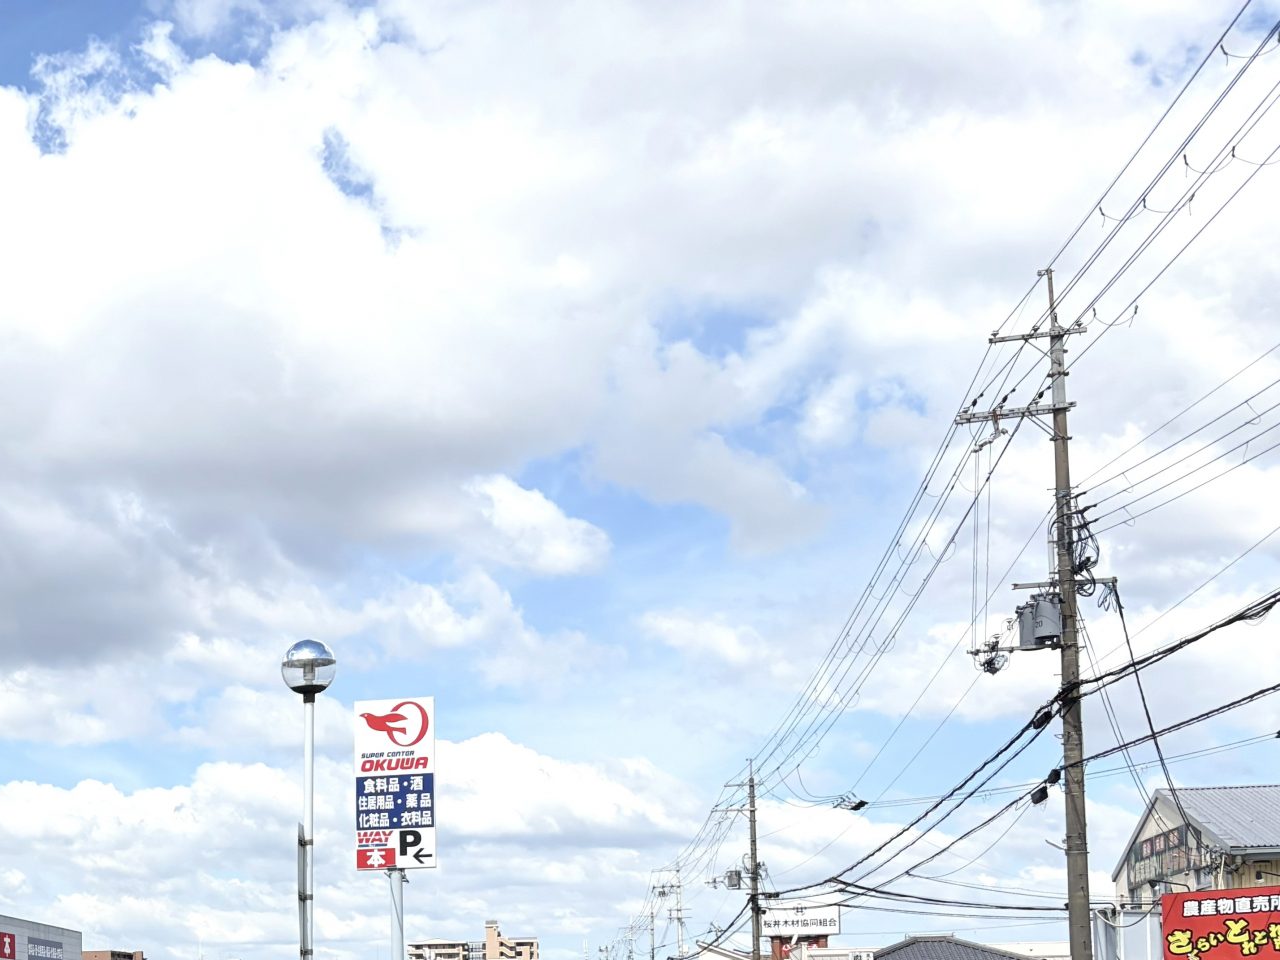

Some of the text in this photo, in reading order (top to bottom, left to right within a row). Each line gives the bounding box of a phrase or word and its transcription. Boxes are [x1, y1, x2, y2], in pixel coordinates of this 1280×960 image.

[386, 750, 415, 758] CENTER
[361, 756, 429, 772] OKUWA
[363, 776, 424, 794] 食料品・酒
[358, 811, 432, 828] 化粧品・衣料品
[357, 830, 393, 844] WAY
[399, 830, 422, 856] P
[366, 849, 386, 867] 本
[763, 918, 837, 928] 桜井木材協同組合
